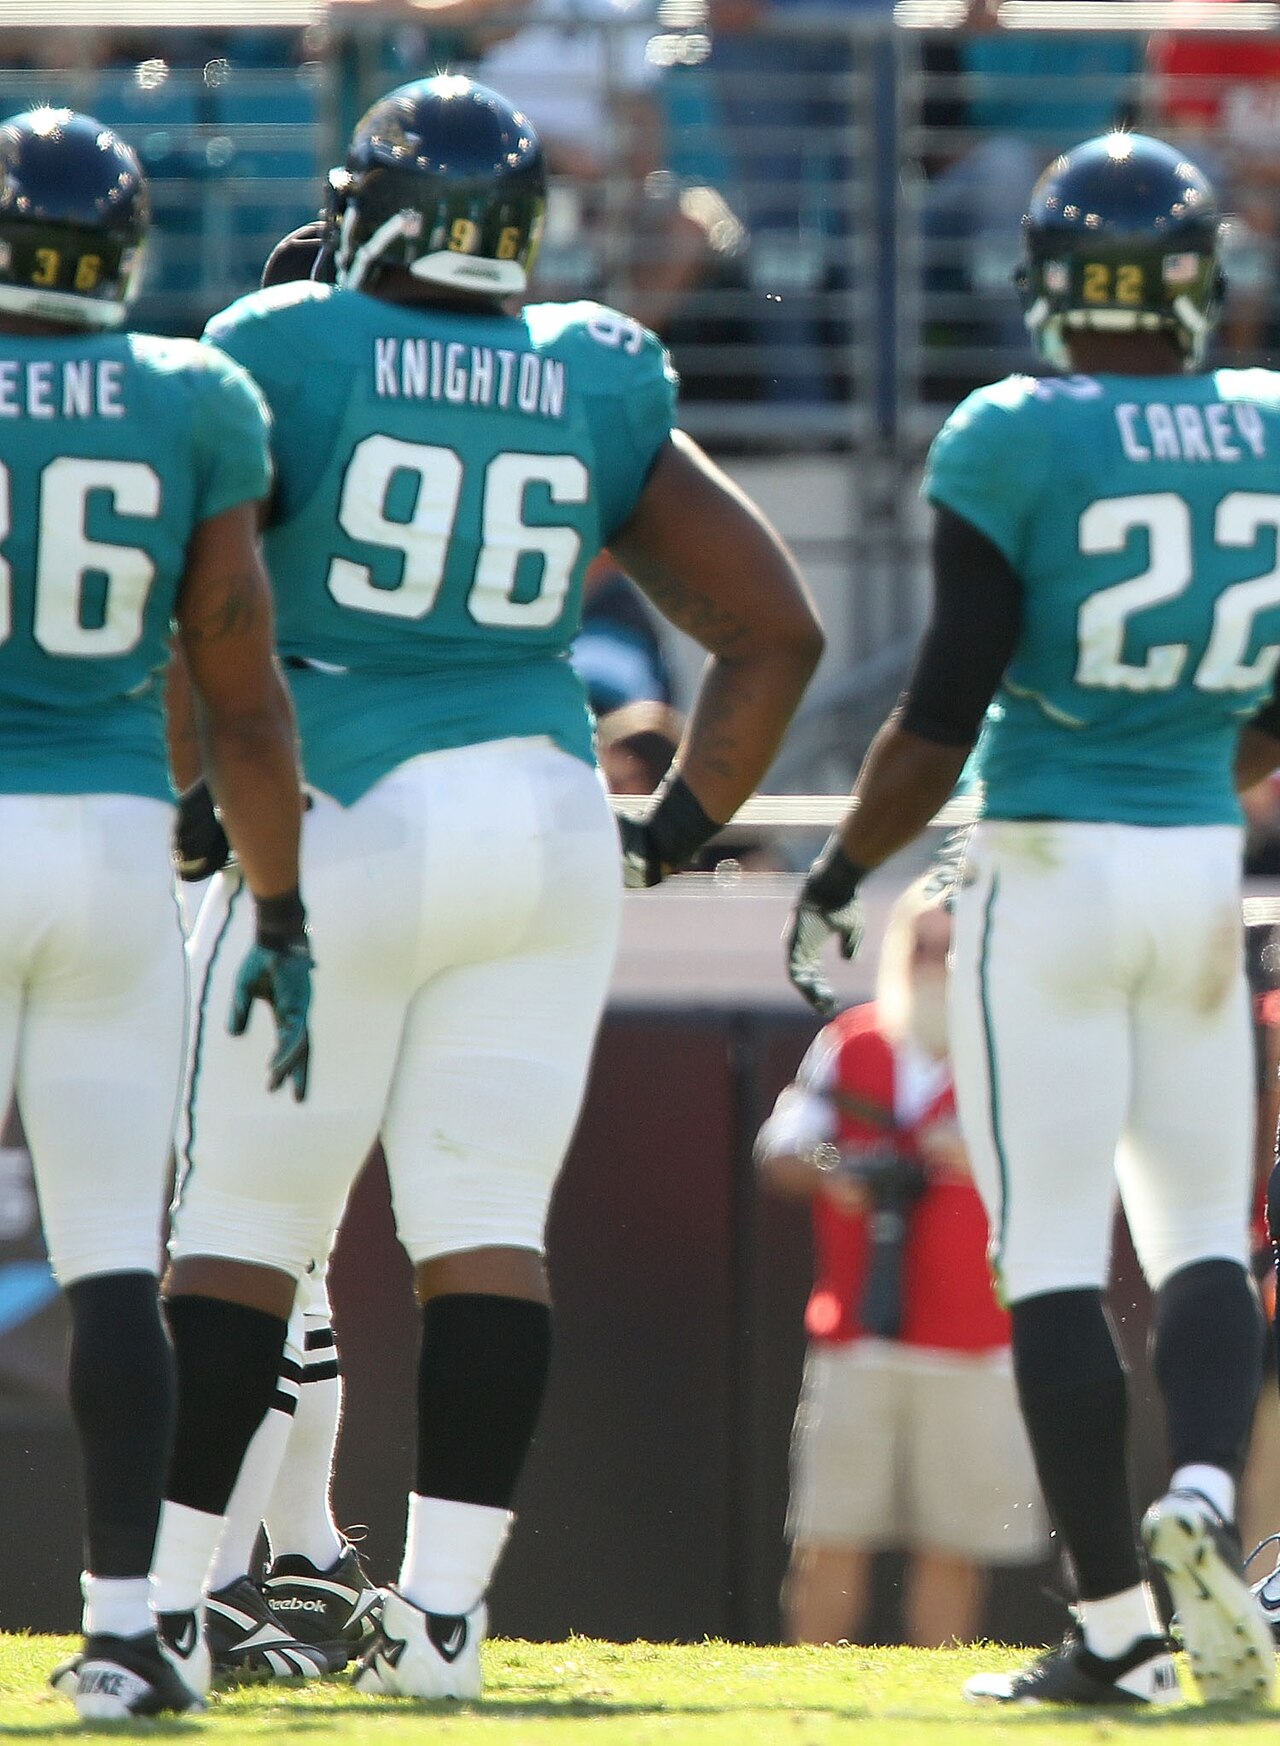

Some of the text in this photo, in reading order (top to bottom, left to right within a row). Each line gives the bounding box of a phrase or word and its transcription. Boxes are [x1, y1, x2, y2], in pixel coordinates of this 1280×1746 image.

[1083, 263, 1144, 304] 22
[373, 336, 566, 418] KNIGHTON
[1114, 402, 1266, 462] CAREY
[0, 454, 162, 660] 6
[326, 433, 588, 629] 96
